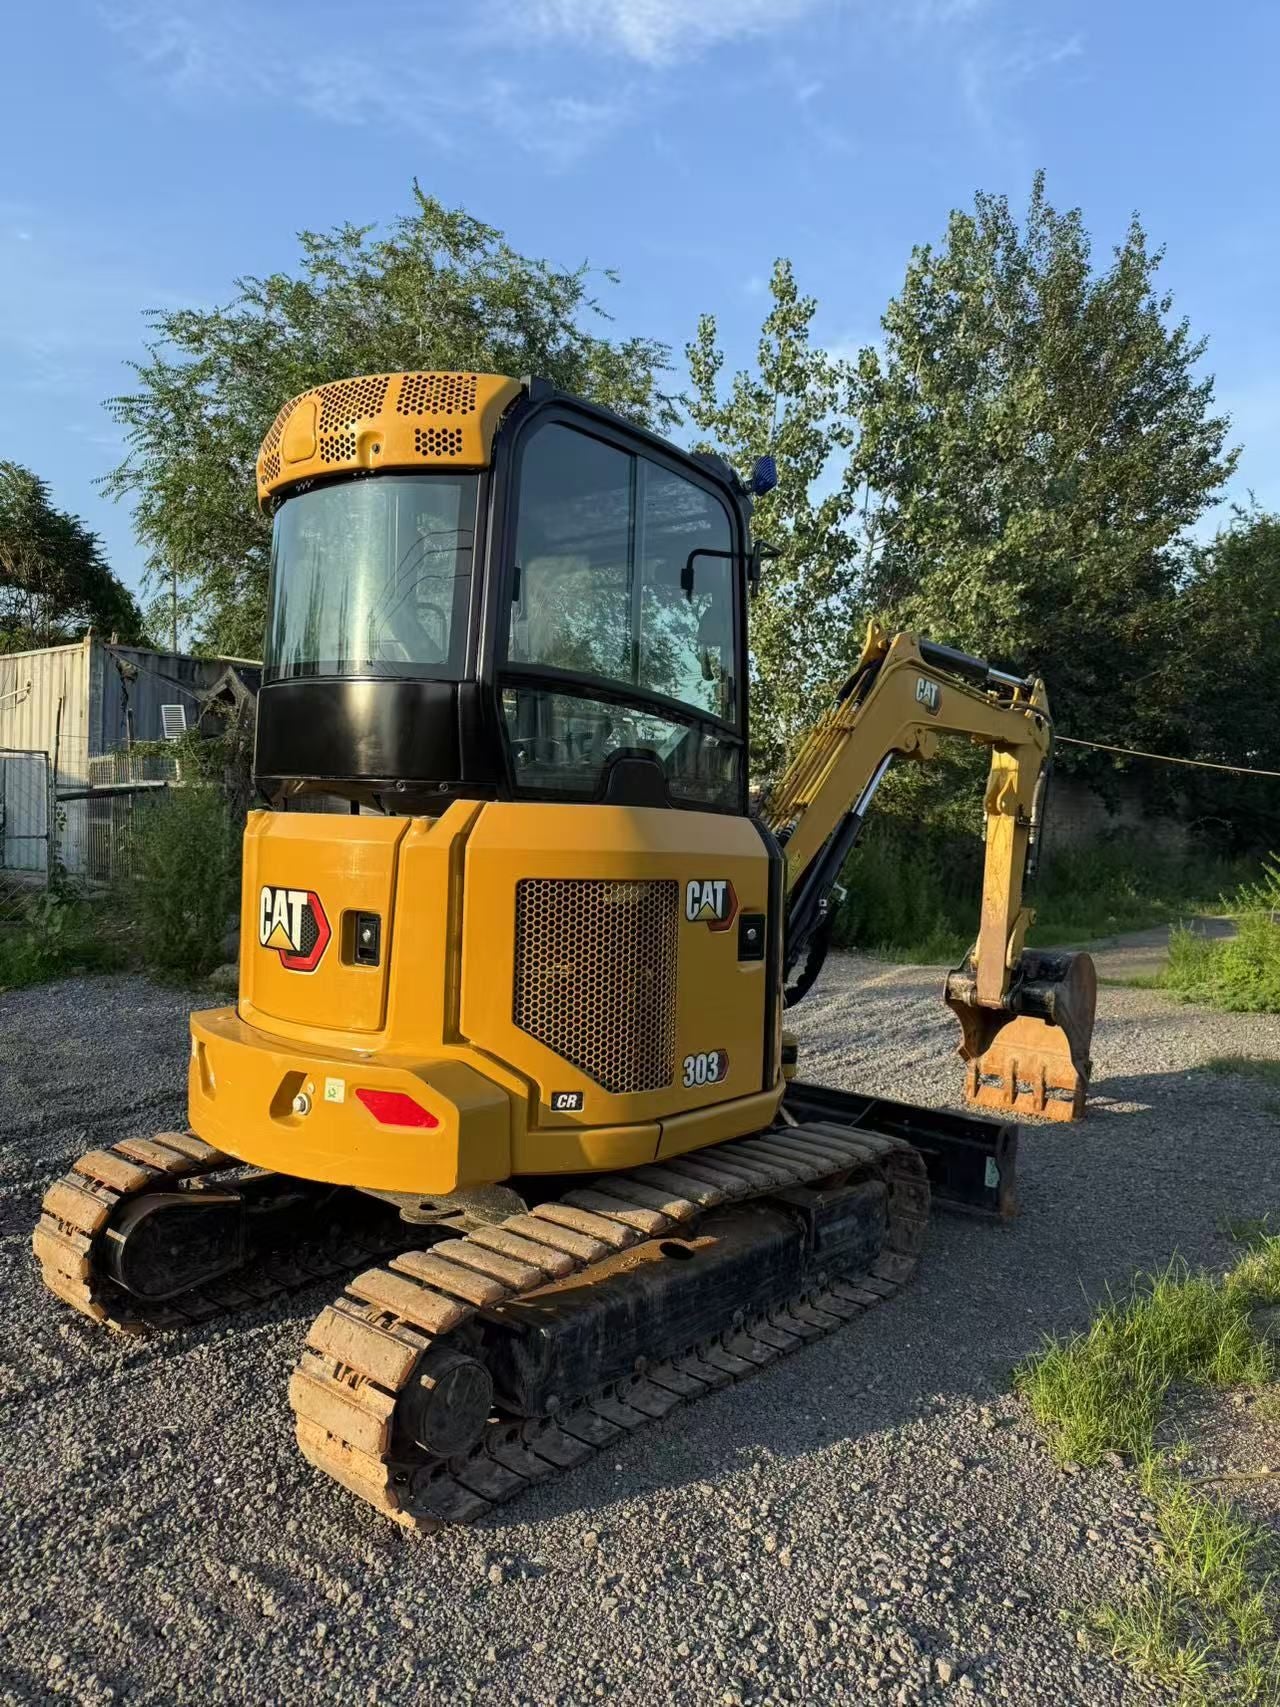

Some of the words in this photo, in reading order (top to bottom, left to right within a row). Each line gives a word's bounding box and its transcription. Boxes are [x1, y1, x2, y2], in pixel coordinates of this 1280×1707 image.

[916, 678, 938, 707] CAT
[687, 880, 726, 920] CAT
[259, 886, 308, 951] CAT
[684, 1052, 718, 1087] 303
[557, 1094, 577, 1107] CR
